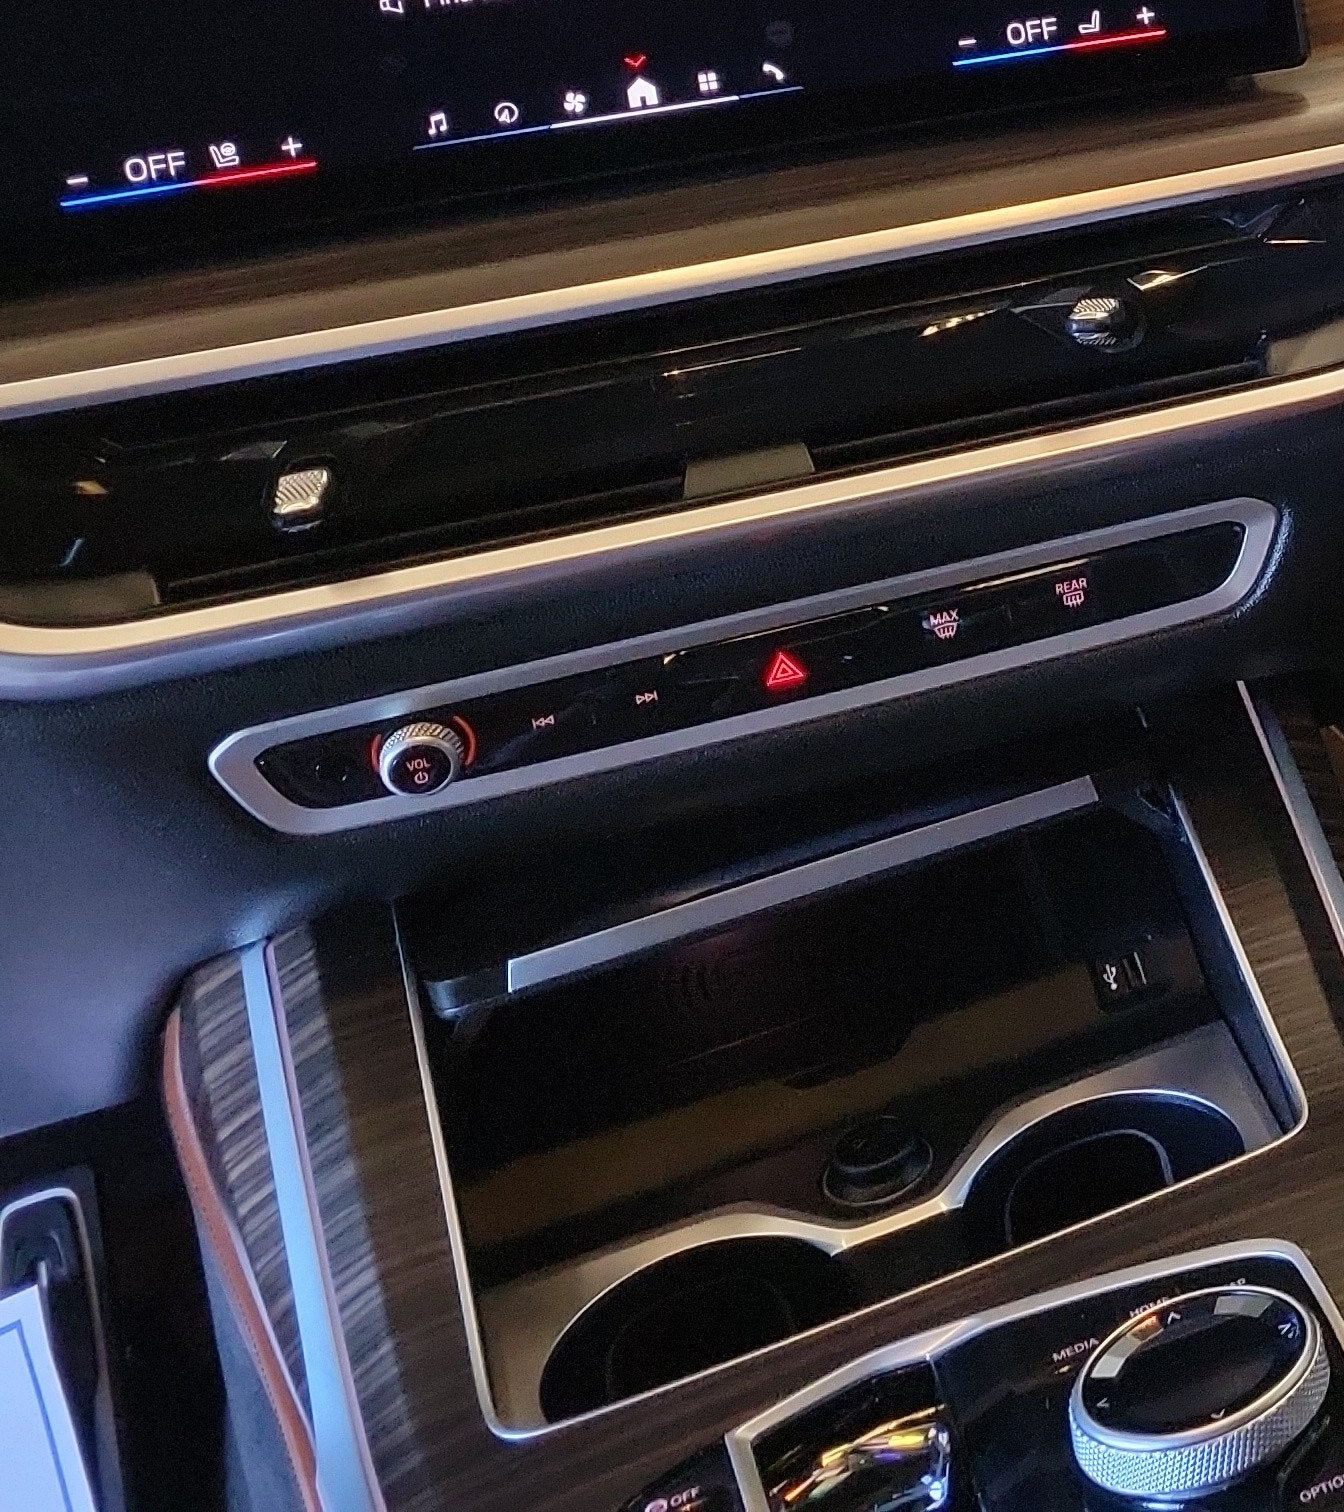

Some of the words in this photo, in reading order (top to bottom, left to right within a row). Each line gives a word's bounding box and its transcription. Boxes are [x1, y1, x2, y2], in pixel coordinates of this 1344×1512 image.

[1005, 16, 1058, 45] OFF
[124, 150, 186, 182] OFF
[1055, 577, 1088, 596] REAR
[929, 608, 960, 626] MAX
[405, 757, 431, 772] VOL
[1052, 1337, 1100, 1363] MEDIA
[670, 1485, 701, 1507] OFF
